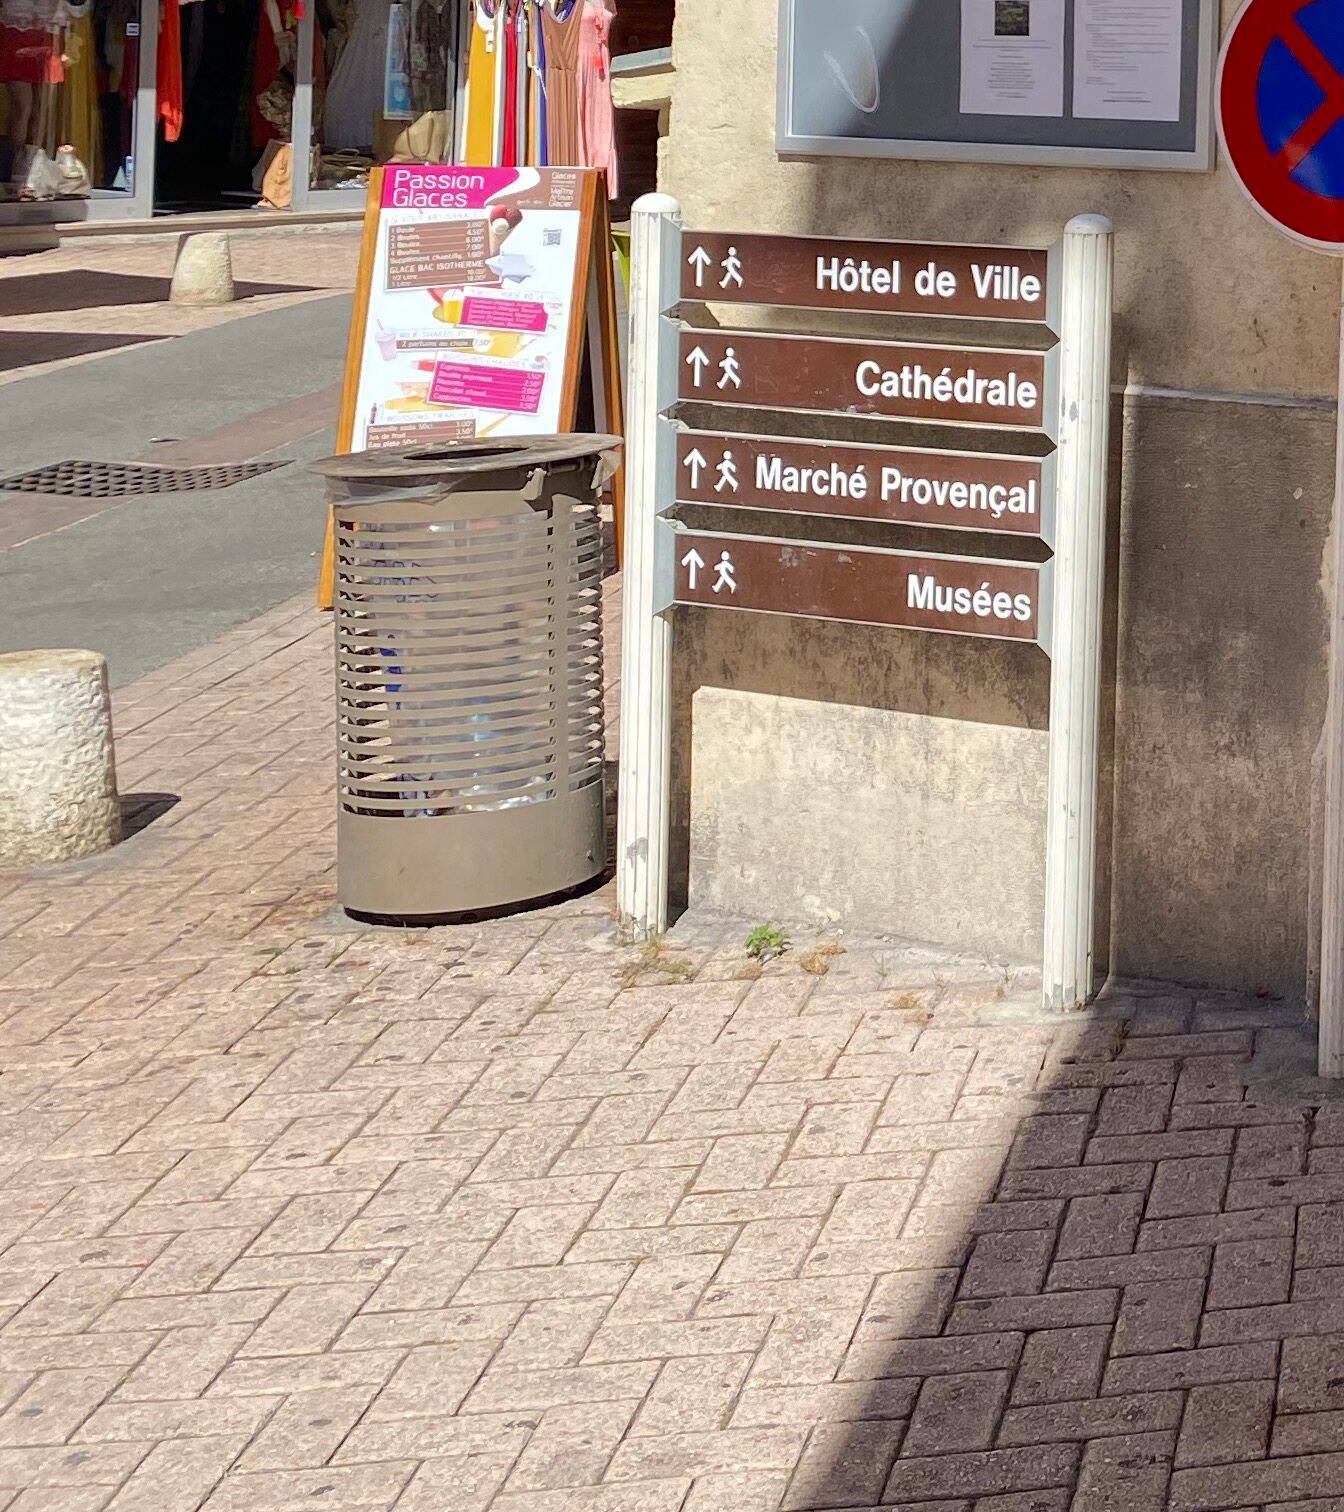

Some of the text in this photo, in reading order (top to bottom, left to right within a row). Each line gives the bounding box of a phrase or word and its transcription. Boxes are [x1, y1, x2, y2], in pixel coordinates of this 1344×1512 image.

[392, 188, 468, 208] Glaces
[394, 169, 486, 190] Passion
[815, 256, 1041, 303] Hôtel de Ville
[854, 359, 1039, 409] Cathédrale
[754, 455, 1036, 520] Marché Provençal
[906, 572, 1032, 622] Musées
